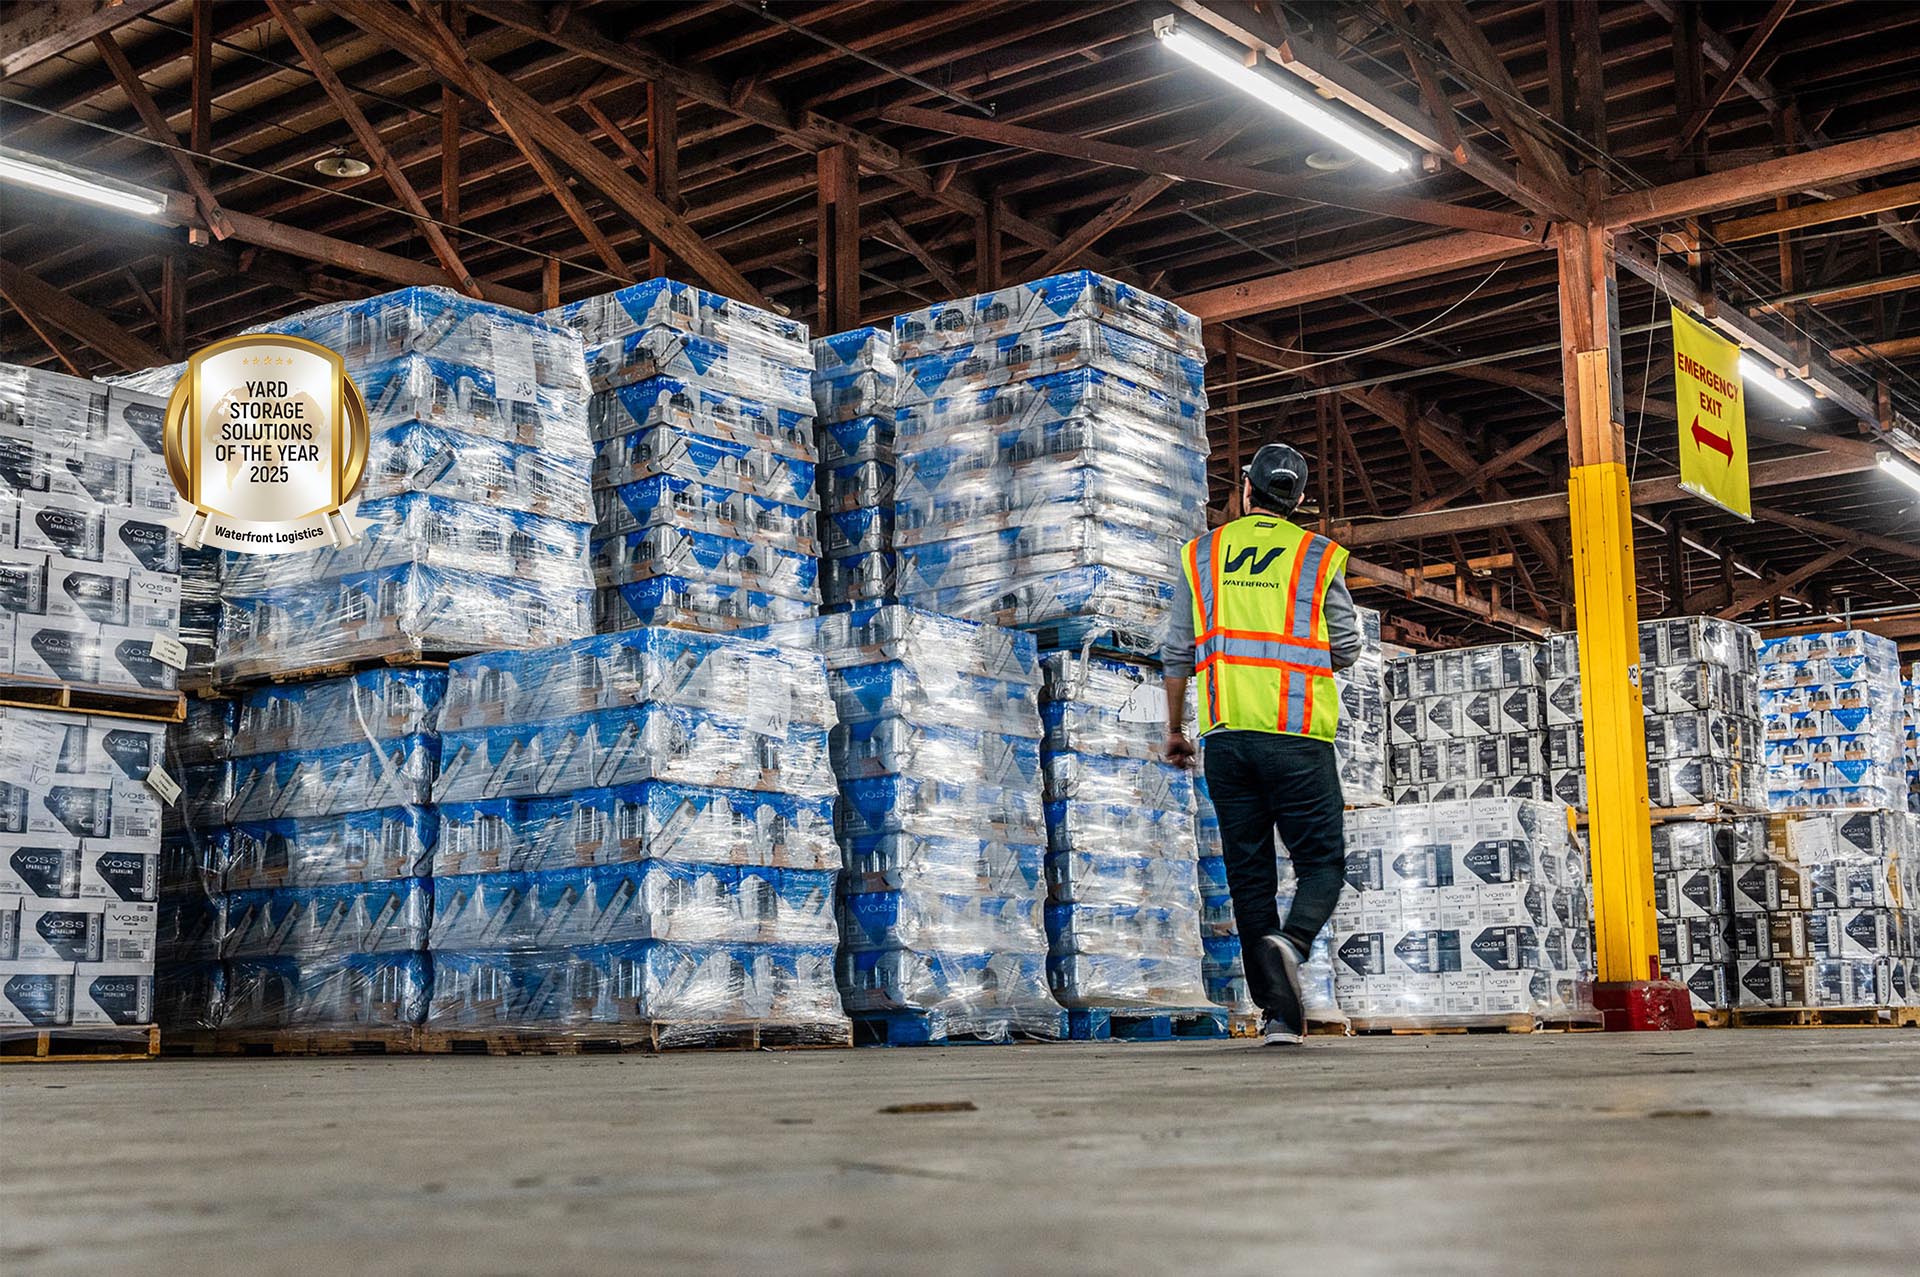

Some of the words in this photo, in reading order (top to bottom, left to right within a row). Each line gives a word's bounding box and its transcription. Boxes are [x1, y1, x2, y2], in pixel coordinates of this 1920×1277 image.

[625, 289, 656, 304] VOSS
[1677, 351, 1739, 403] EMERGENCY
[1699, 391, 1723, 420] EXIT
[689, 449, 717, 462] VOSS
[141, 463, 167, 475] VOS
[42, 513, 83, 526] VOSS
[50, 523, 75, 532] SPARKLING
[124, 527, 164, 540] VOSS
[137, 582, 172, 593] VOSS
[1223, 580, 1280, 589] WATERFRONT
[121, 647, 150, 657] VOS
[853, 672, 896, 686] VOSS
[108, 736, 148, 749] VOSS
[16, 855, 59, 865] VOSS
[1467, 854, 1497, 862] VOSS
[101, 860, 141, 869] VOSS
[545, 871, 580, 882] VOSS
[858, 902, 897, 914] VOSS
[112, 914, 149, 923] VOSS
[42, 920, 85, 929] VOSS
[1341, 947, 1370, 955] VOSS
[10, 983, 54, 992] VOSS
[95, 983, 135, 992] VOSS
